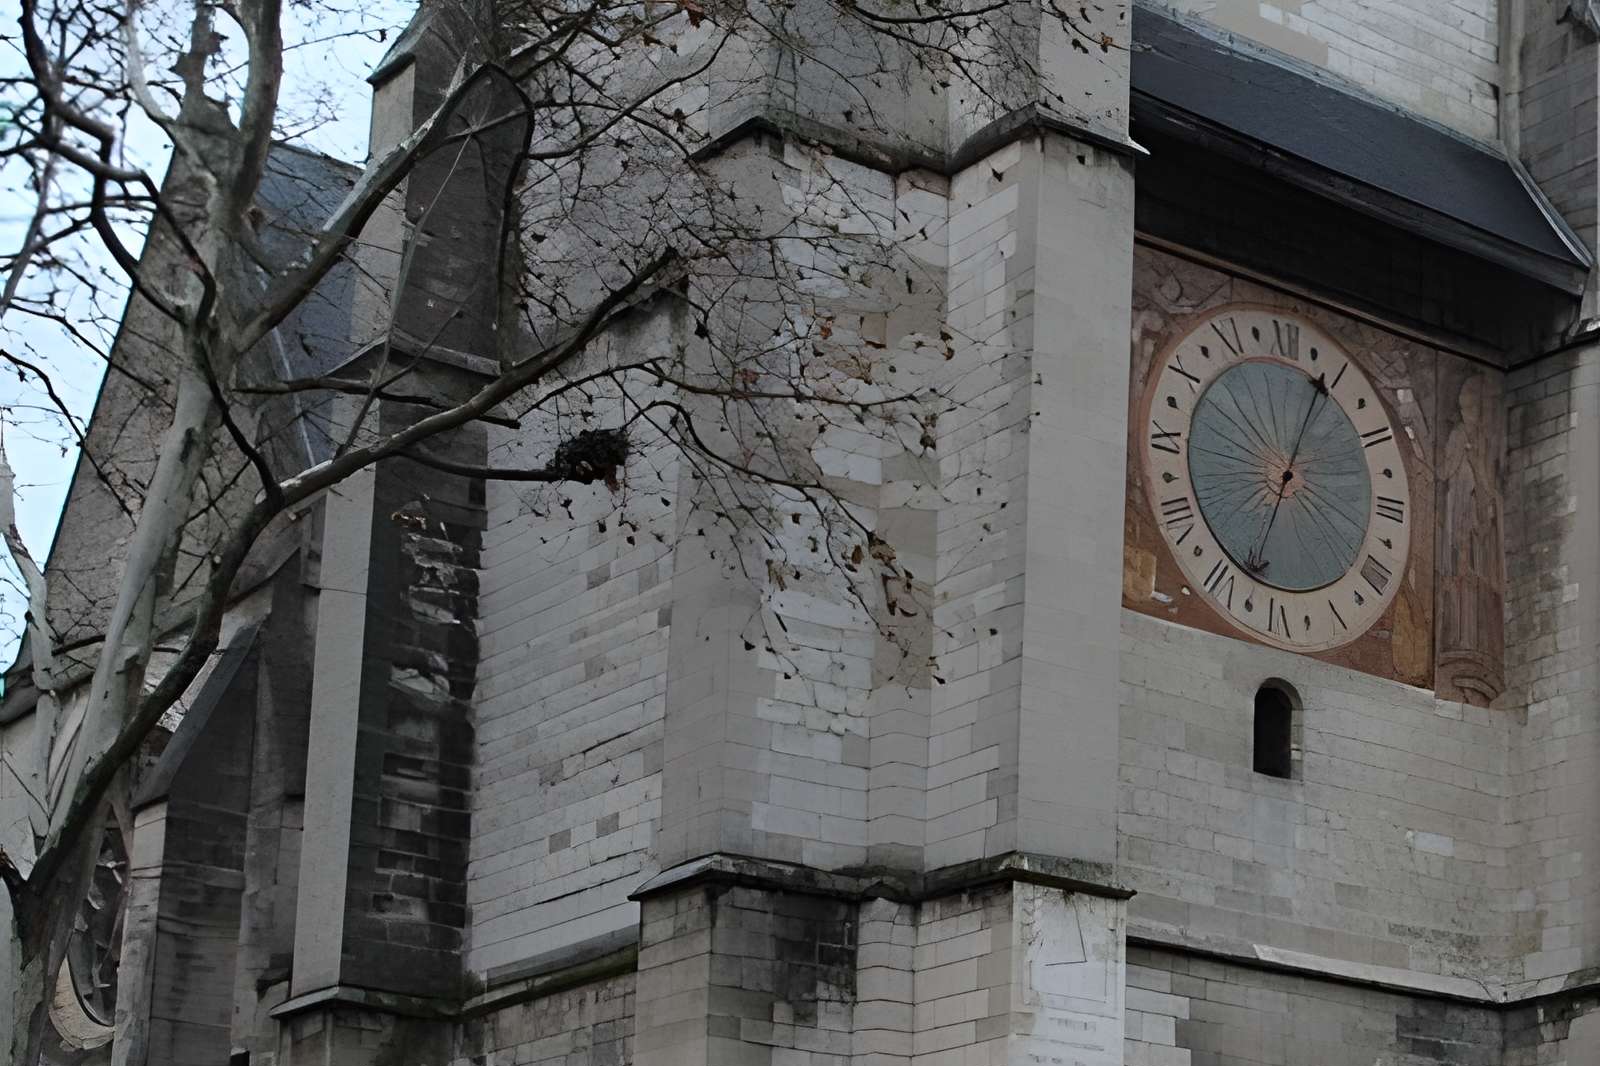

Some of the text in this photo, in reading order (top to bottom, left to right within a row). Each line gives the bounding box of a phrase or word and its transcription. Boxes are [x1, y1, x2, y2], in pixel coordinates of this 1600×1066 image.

[1151, 419, 1182, 454] IX
[1360, 427, 1393, 448] II
[1376, 496, 1404, 523] III
